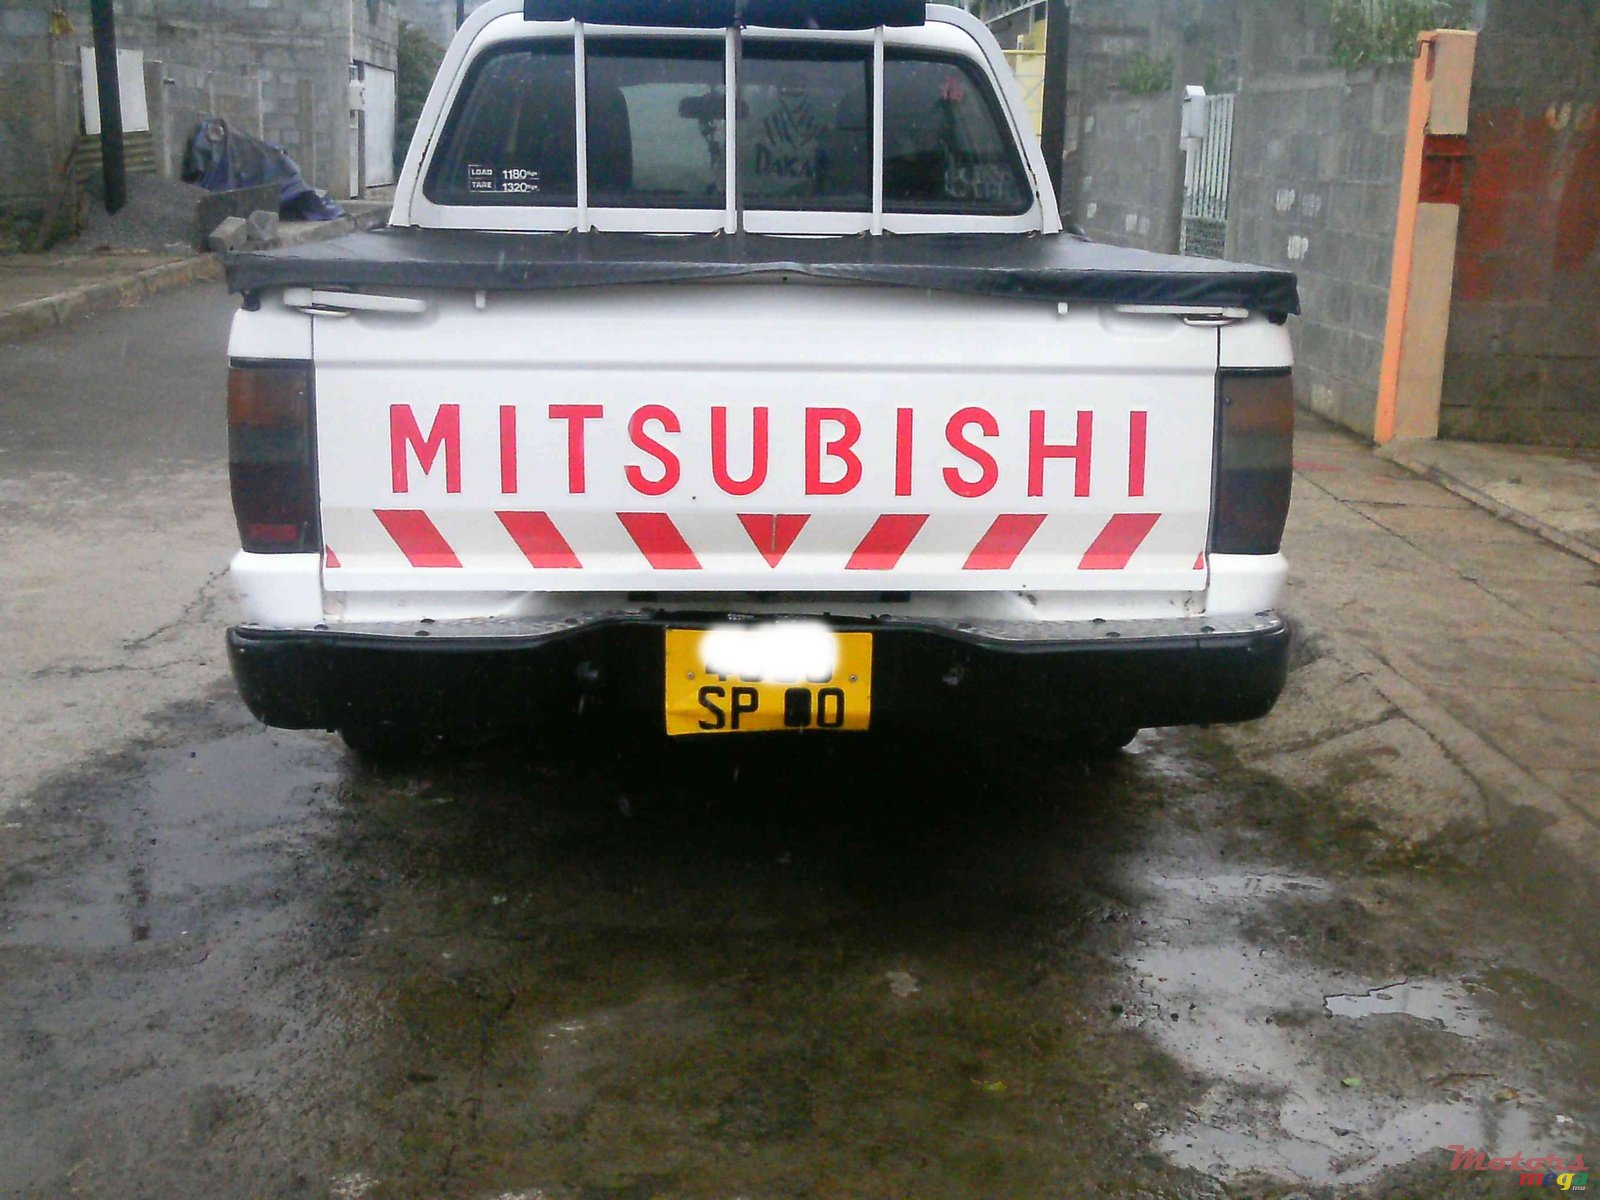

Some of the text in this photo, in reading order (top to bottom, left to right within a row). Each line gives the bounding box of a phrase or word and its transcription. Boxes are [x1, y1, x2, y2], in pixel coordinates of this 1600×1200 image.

[471, 168, 493, 176] LOAD
[502, 169, 527, 180] 1180
[471, 181, 493, 189] TARE
[502, 182, 527, 192] 1320
[390, 404, 1147, 498] MITSUBISHI
[698, 686, 760, 730] SP
